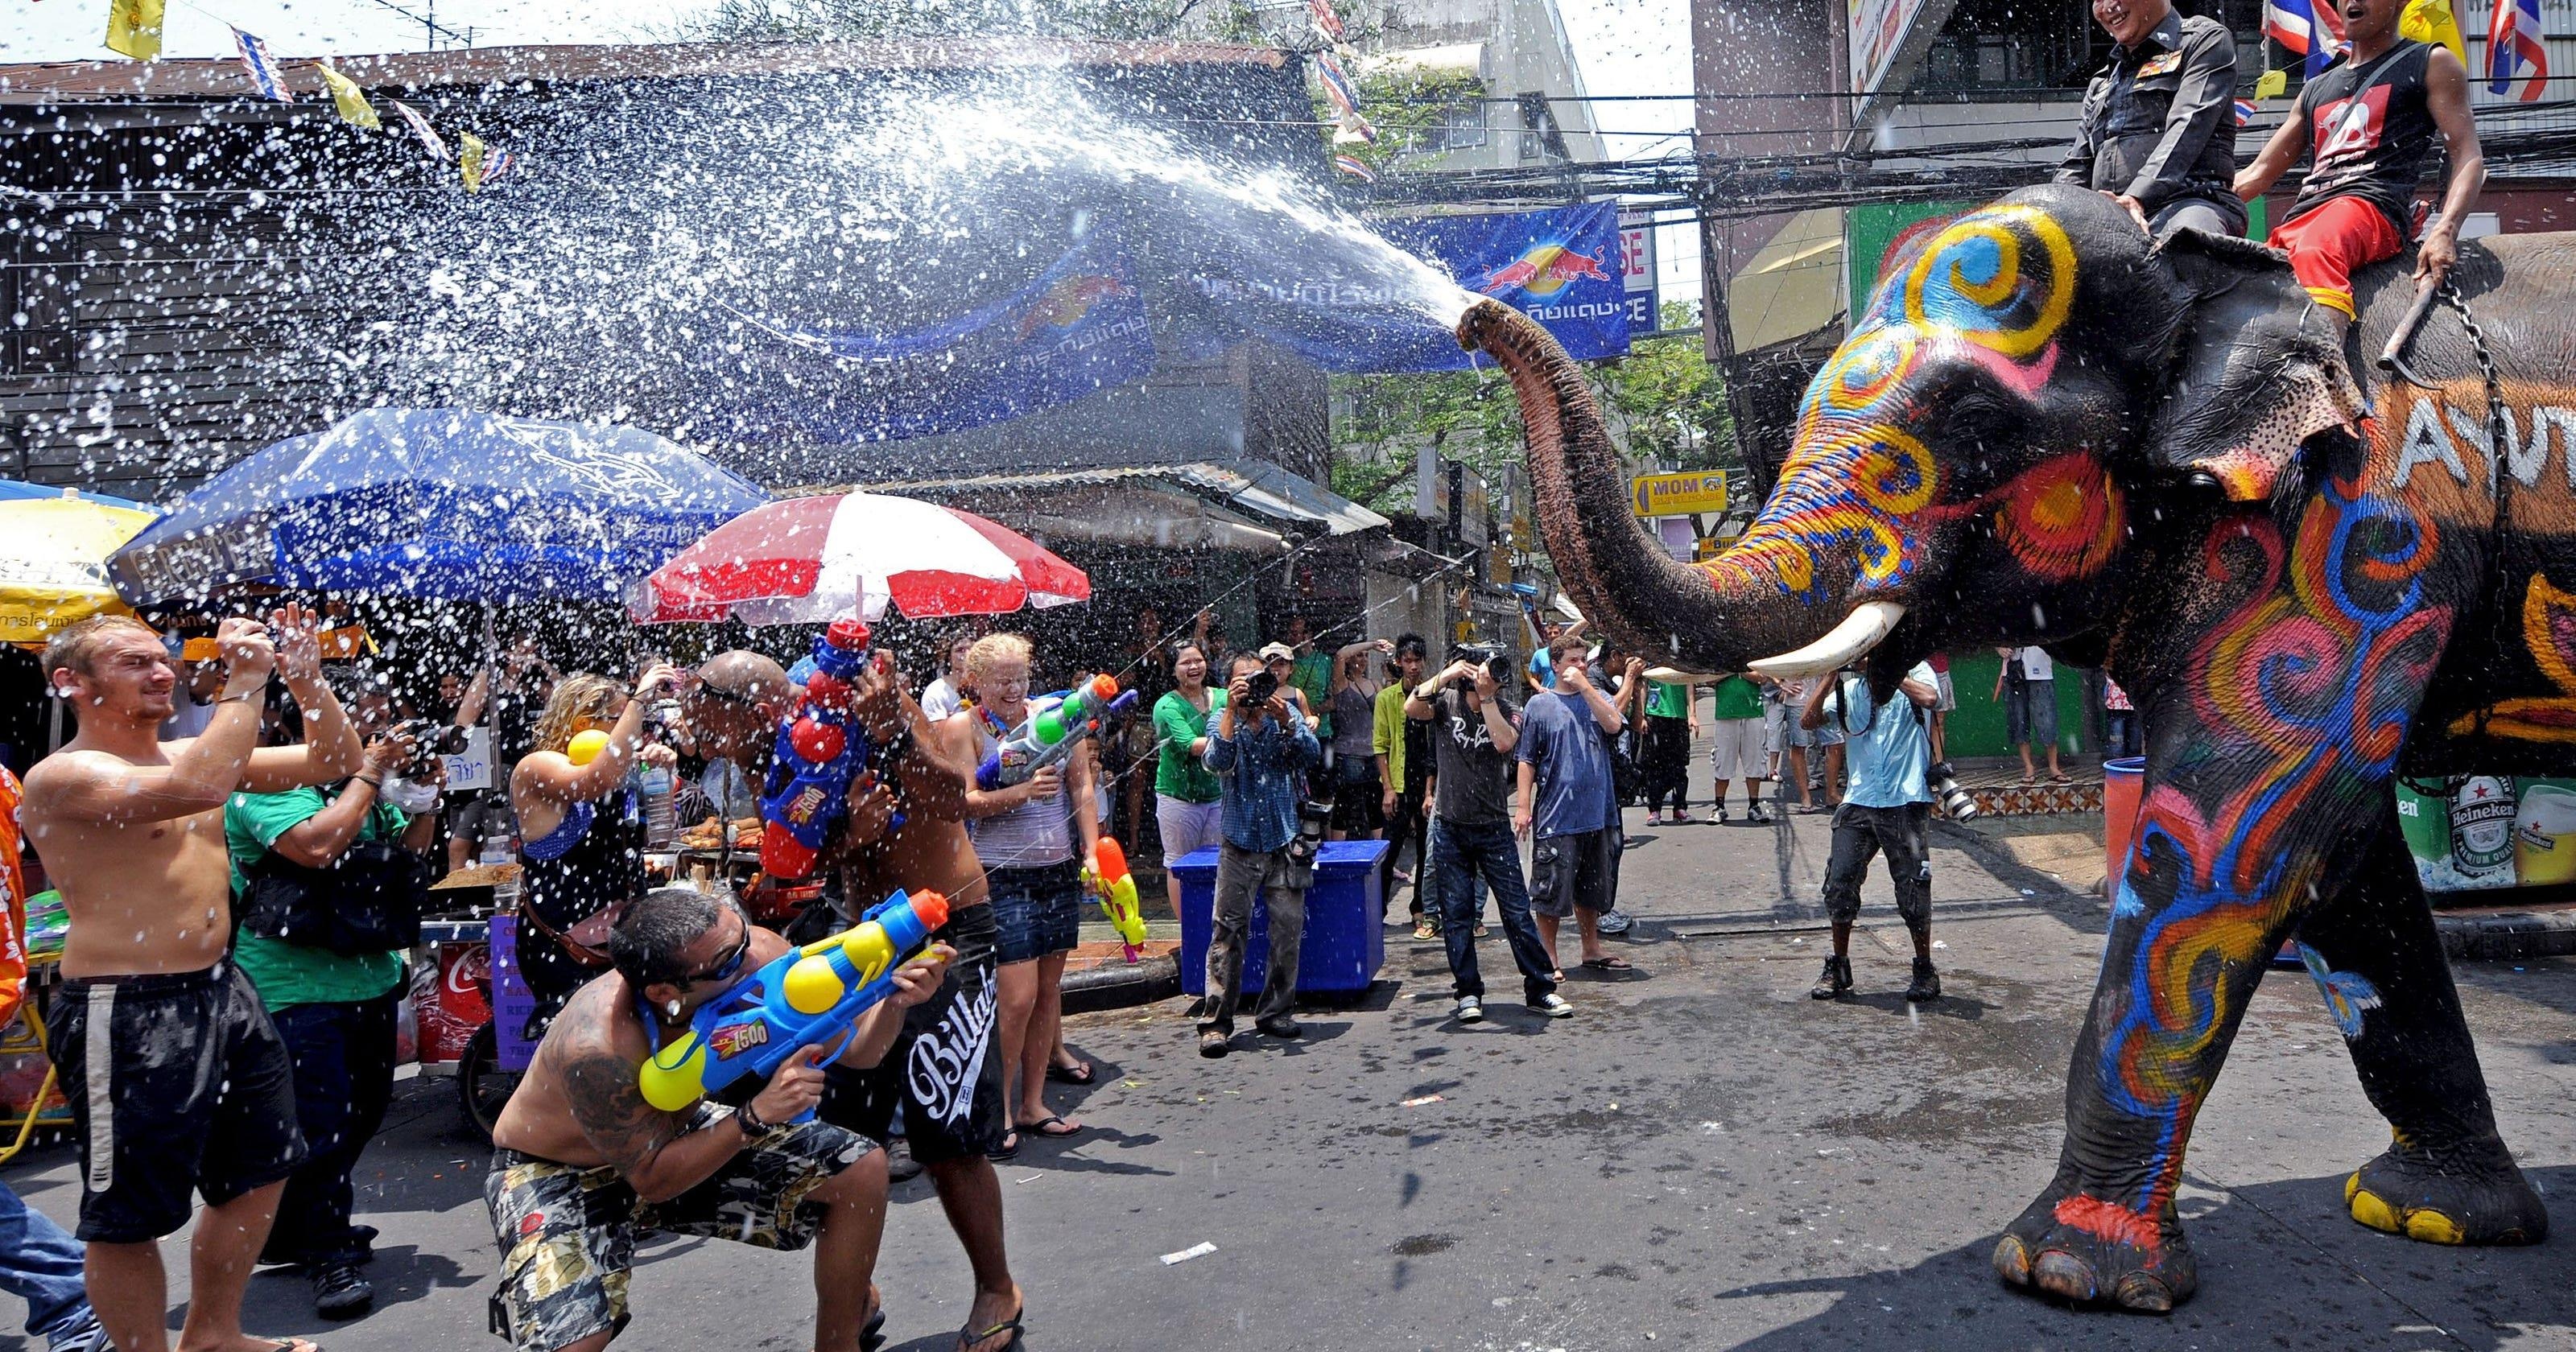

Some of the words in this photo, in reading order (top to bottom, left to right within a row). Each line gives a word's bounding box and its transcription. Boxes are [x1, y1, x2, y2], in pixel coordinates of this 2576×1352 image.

[1653, 478, 1699, 496] MOM
[1451, 715, 1492, 748] Ray-Ba
[797, 788, 826, 815] 1500
[2452, 803, 2515, 826] Heineken
[2457, 842, 2490, 864] PREMIUM
[733, 1024, 768, 1052] 1500
